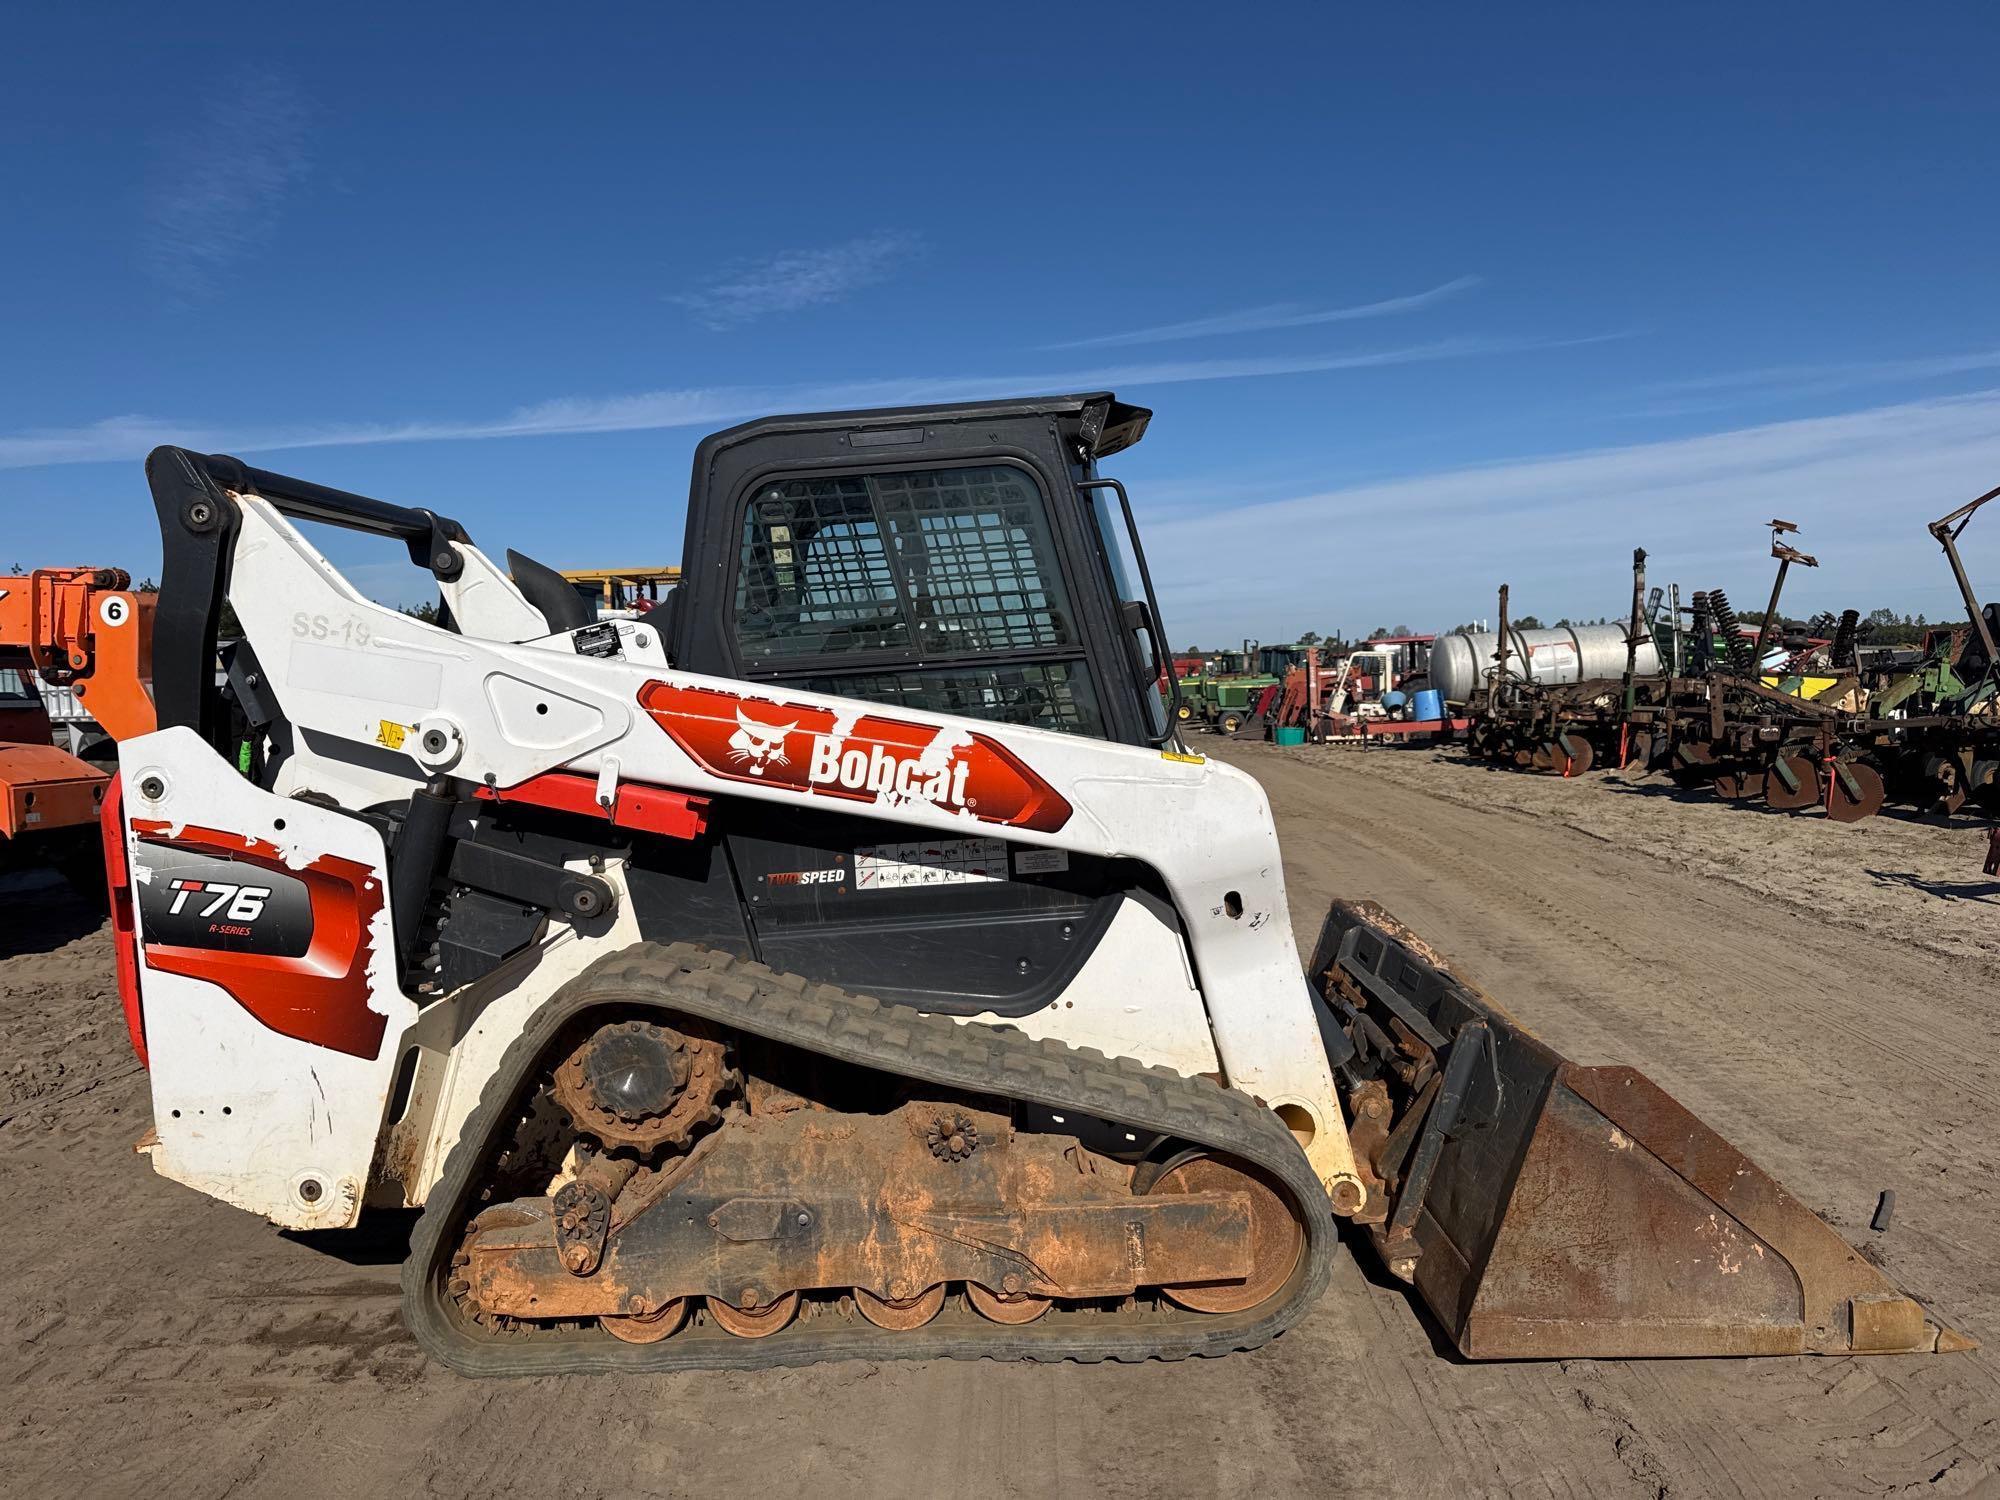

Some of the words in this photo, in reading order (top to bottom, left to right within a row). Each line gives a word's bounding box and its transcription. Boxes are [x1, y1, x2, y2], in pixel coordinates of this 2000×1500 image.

[108, 602, 122, 620] 6
[808, 734, 970, 806] Bobcat
[801, 869, 845, 884] SPEED
[168, 879, 272, 921] T76
[208, 924, 252, 936] R-SERIES
